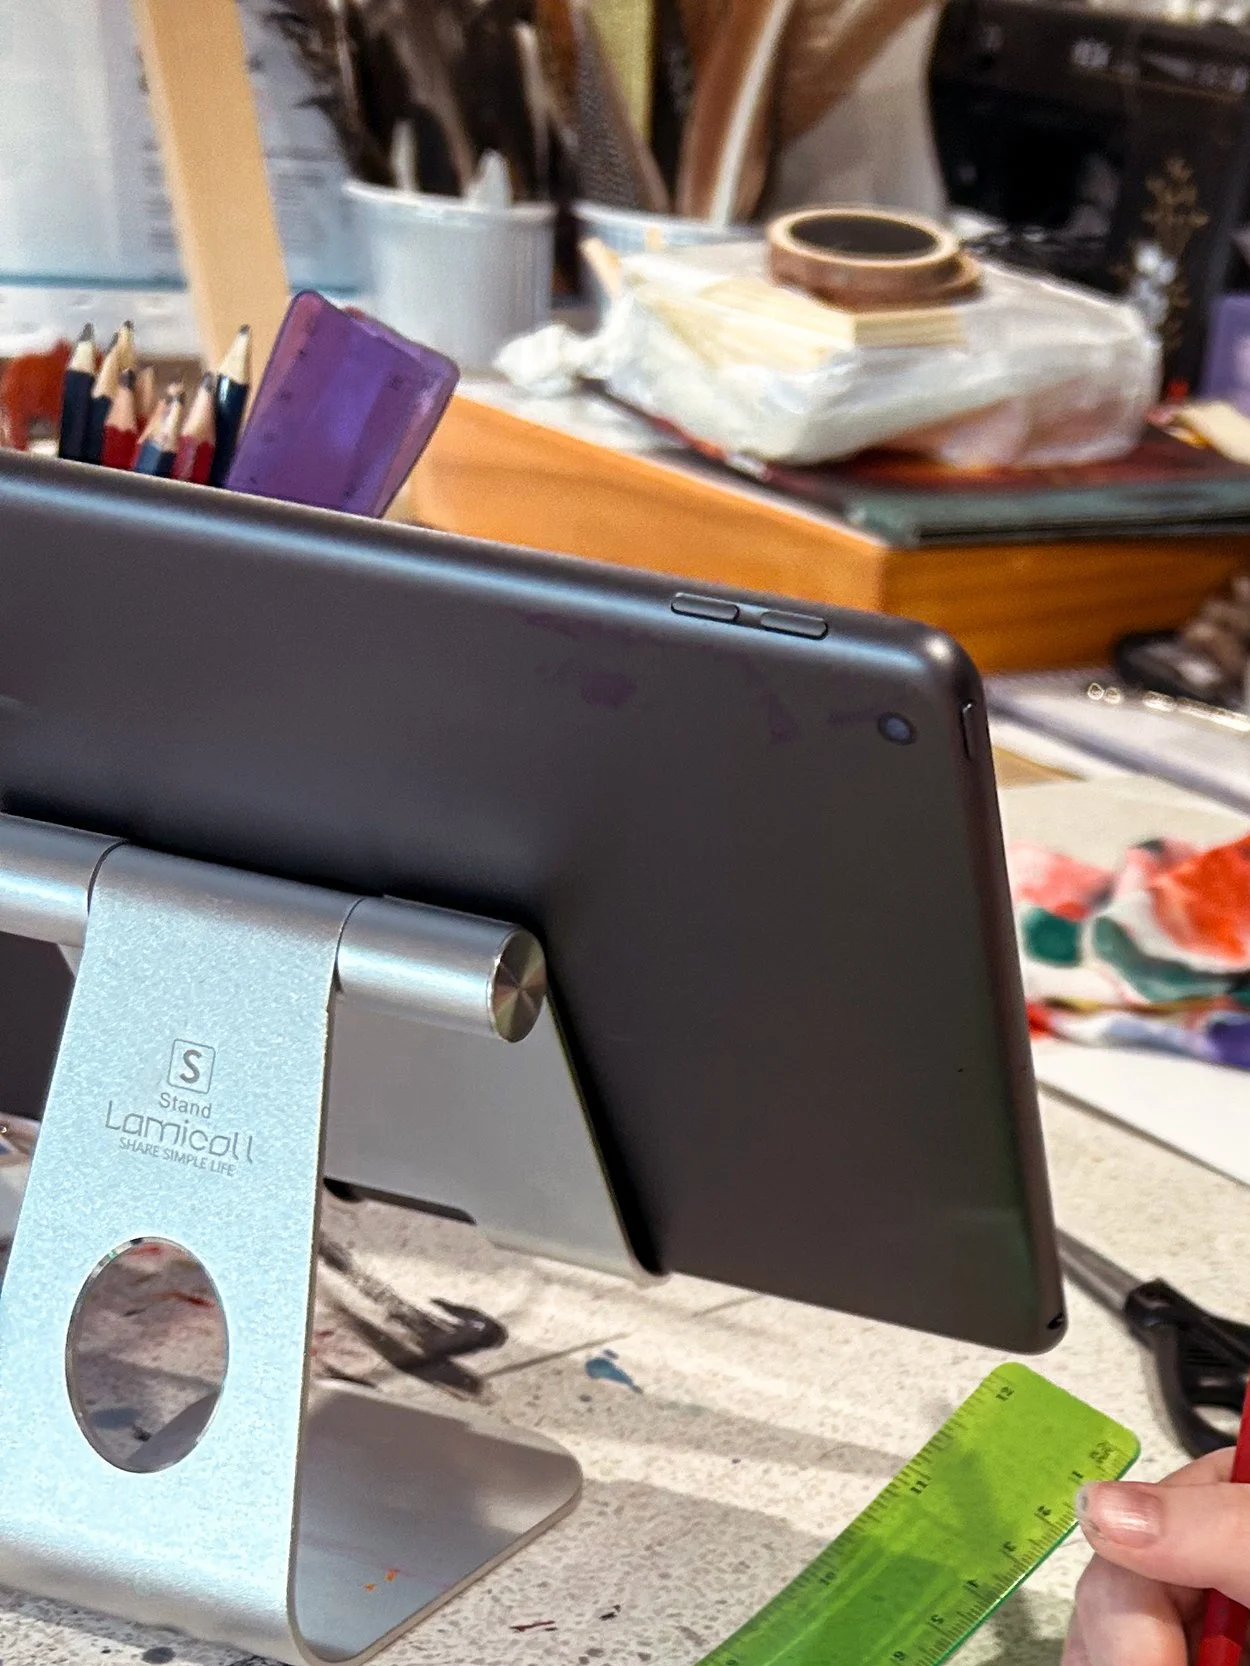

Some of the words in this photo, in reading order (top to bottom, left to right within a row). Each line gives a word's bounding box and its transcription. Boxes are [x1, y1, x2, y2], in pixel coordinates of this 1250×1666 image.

[179, 1049, 202, 1083] S
[158, 1092, 212, 1119] Stand
[119, 1137, 160, 1158] SHARE
[163, 1148, 208, 1170] SIMPLE
[210, 1160, 236, 1177] LIFE
[820, 1571, 837, 1586] 10
[910, 1480, 929, 1495] 11
[995, 1386, 1015, 1402] 12
[1037, 1505, 1052, 1517] 2
[1003, 1541, 1017, 1552] 3
[966, 1579, 980, 1589] 4
[930, 1614, 945, 1625] 5
[892, 1650, 905, 1661] 6
